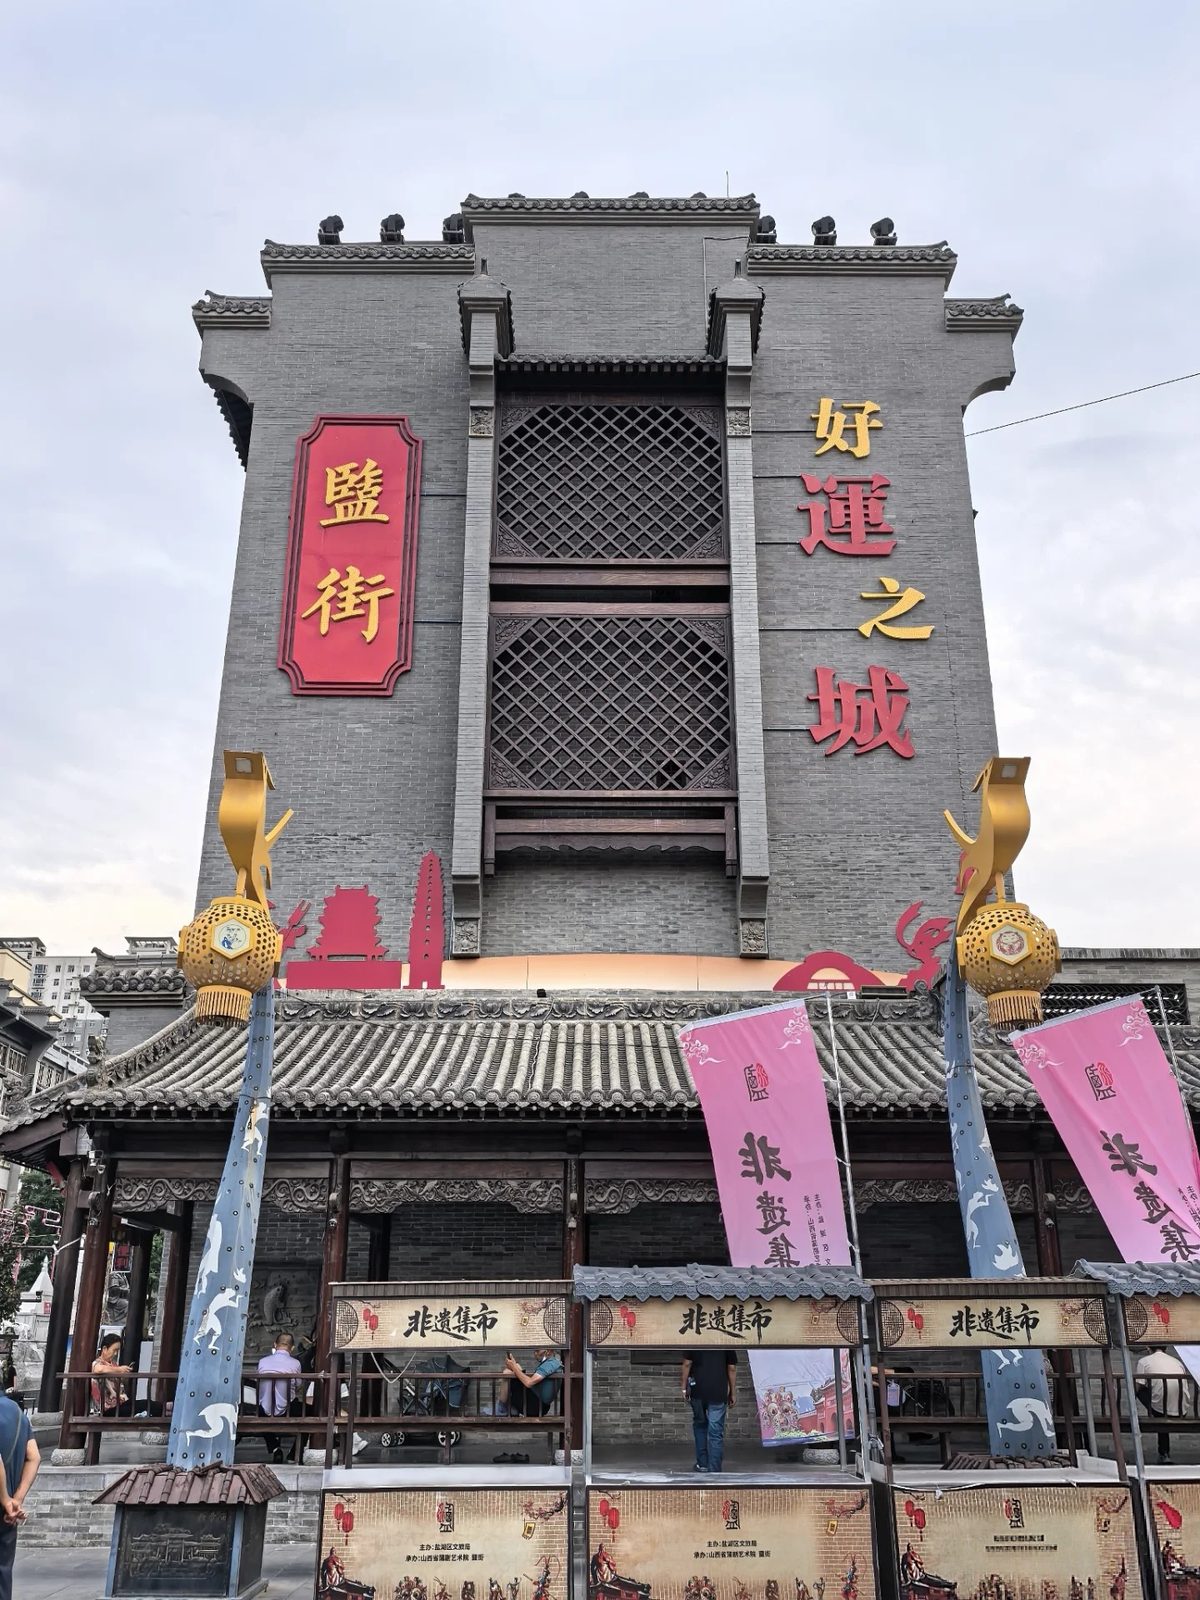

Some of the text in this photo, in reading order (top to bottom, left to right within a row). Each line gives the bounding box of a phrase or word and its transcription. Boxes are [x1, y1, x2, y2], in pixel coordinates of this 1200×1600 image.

[797, 397, 935, 759] 好運之城
[403, 1303, 499, 1346] 非遗集市
[679, 1302, 773, 1344] 非遗集市
[949, 1303, 1040, 1344] 非遗集市
